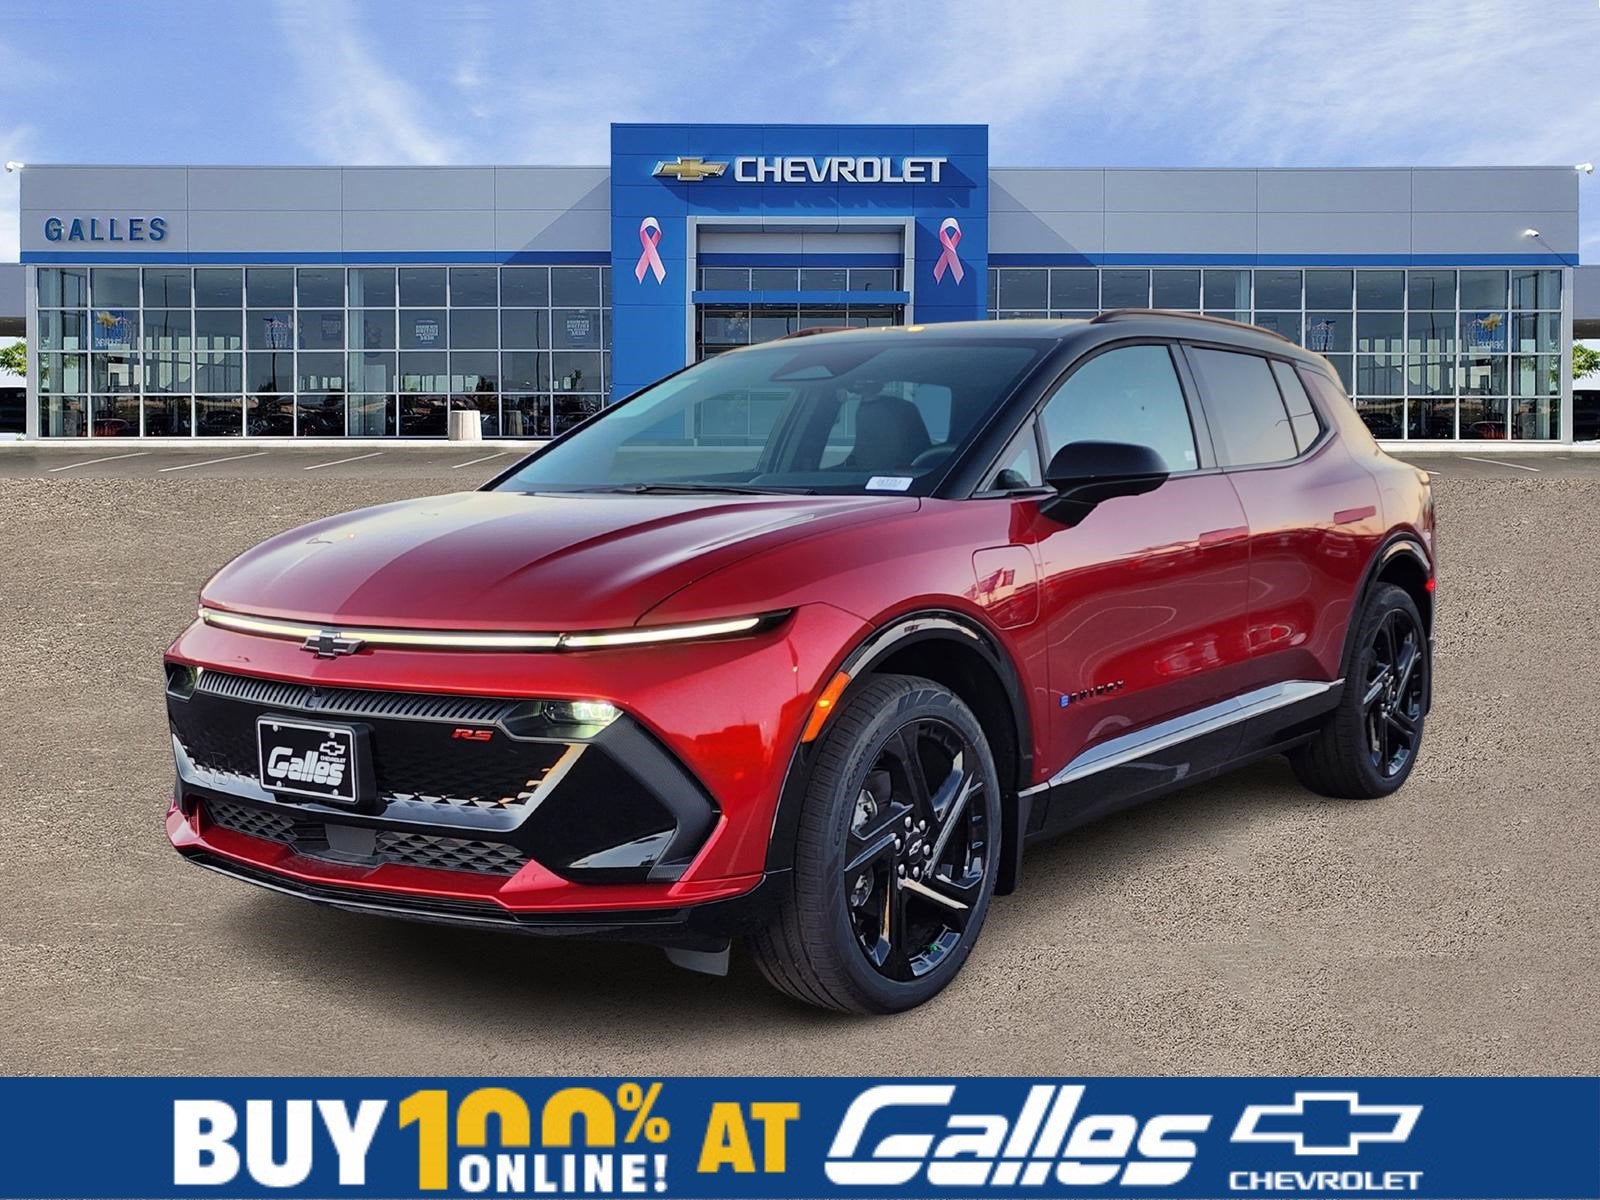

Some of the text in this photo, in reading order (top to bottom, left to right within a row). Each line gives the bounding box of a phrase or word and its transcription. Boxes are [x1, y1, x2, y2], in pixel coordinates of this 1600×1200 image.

[734, 156, 948, 183] CHEVROLET
[44, 216, 167, 242] GALLES
[451, 727, 493, 741] RS
[267, 746, 345, 786] Galles
